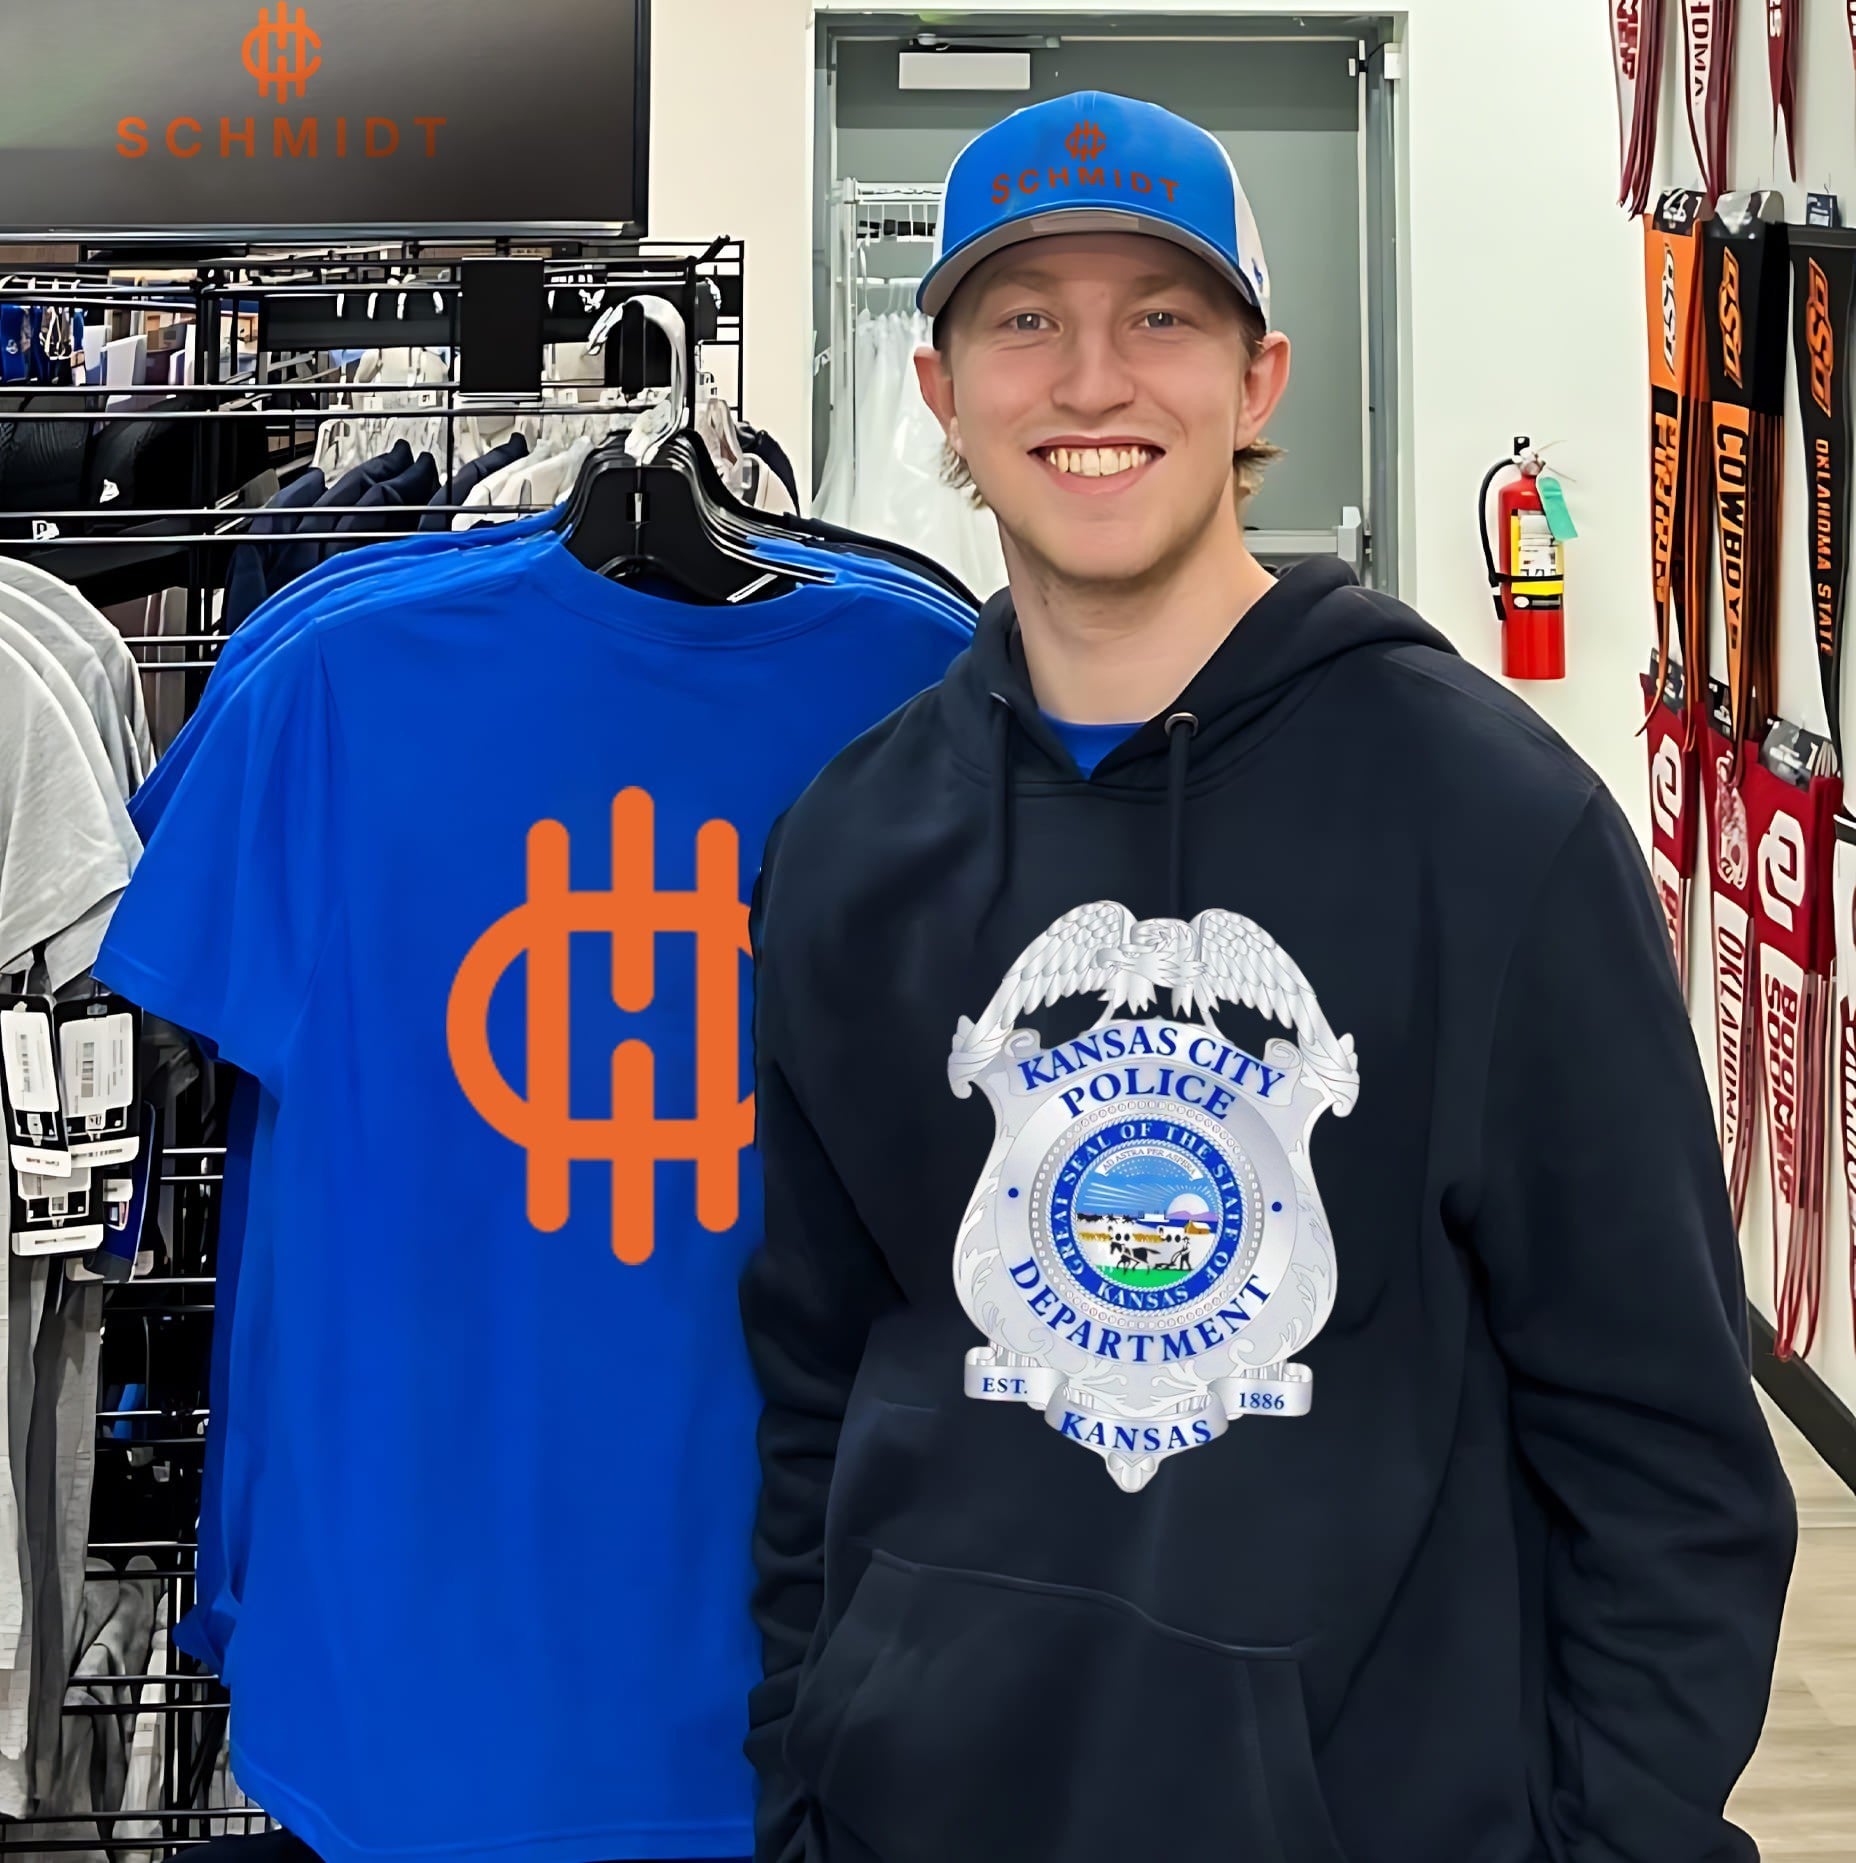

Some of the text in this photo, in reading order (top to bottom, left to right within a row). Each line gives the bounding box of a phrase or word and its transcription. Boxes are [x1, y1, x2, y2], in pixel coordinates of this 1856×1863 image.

[115, 116, 447, 159] SCHMIDT
[991, 166, 1179, 204] SCHMIDT
[1017, 1026, 1285, 1098] KANSAS CITY
[1059, 1067, 1236, 1120] POLICE
[1101, 1158, 1116, 1172] AD
[1113, 1148, 1145, 1167] ASTRA
[1165, 1152, 1197, 1175] ASPERA
[1053, 1122, 1240, 1284] GREAT SEAL OF THE STATE OF
[1009, 1256, 1271, 1363] DEPARTMENT
[1096, 1283, 1190, 1309] KANSAS
[982, 1376, 1028, 1394] EST.
[1238, 1391, 1285, 1410] 1886
[1060, 1410, 1212, 1451] KANSAS
